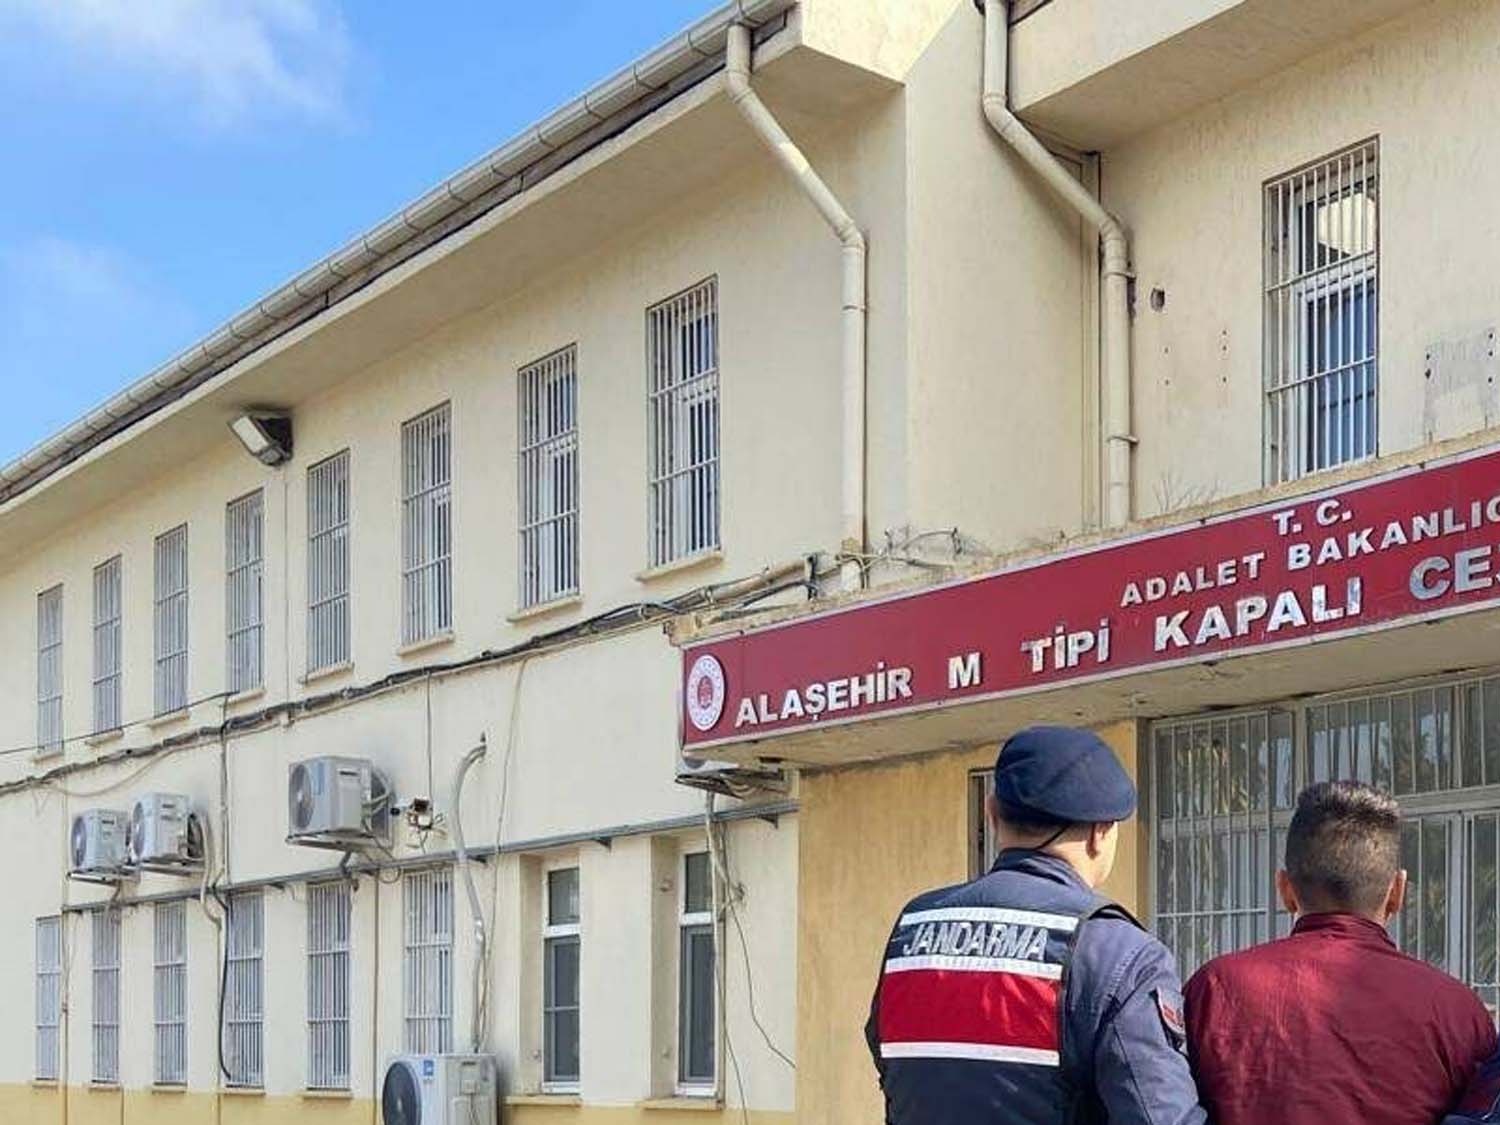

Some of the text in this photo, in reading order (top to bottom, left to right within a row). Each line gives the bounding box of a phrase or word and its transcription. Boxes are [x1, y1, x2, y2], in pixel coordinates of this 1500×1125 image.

[1272, 499, 1353, 536] T. C.
[1120, 551, 1265, 608] ADALET
[734, 661, 913, 722] ALAŞEHİR
[948, 651, 982, 690] M
[1020, 617, 1111, 673] TİPİ
[1153, 576, 1363, 652] KAPALI
[903, 921, 1049, 961] JANDARMA
